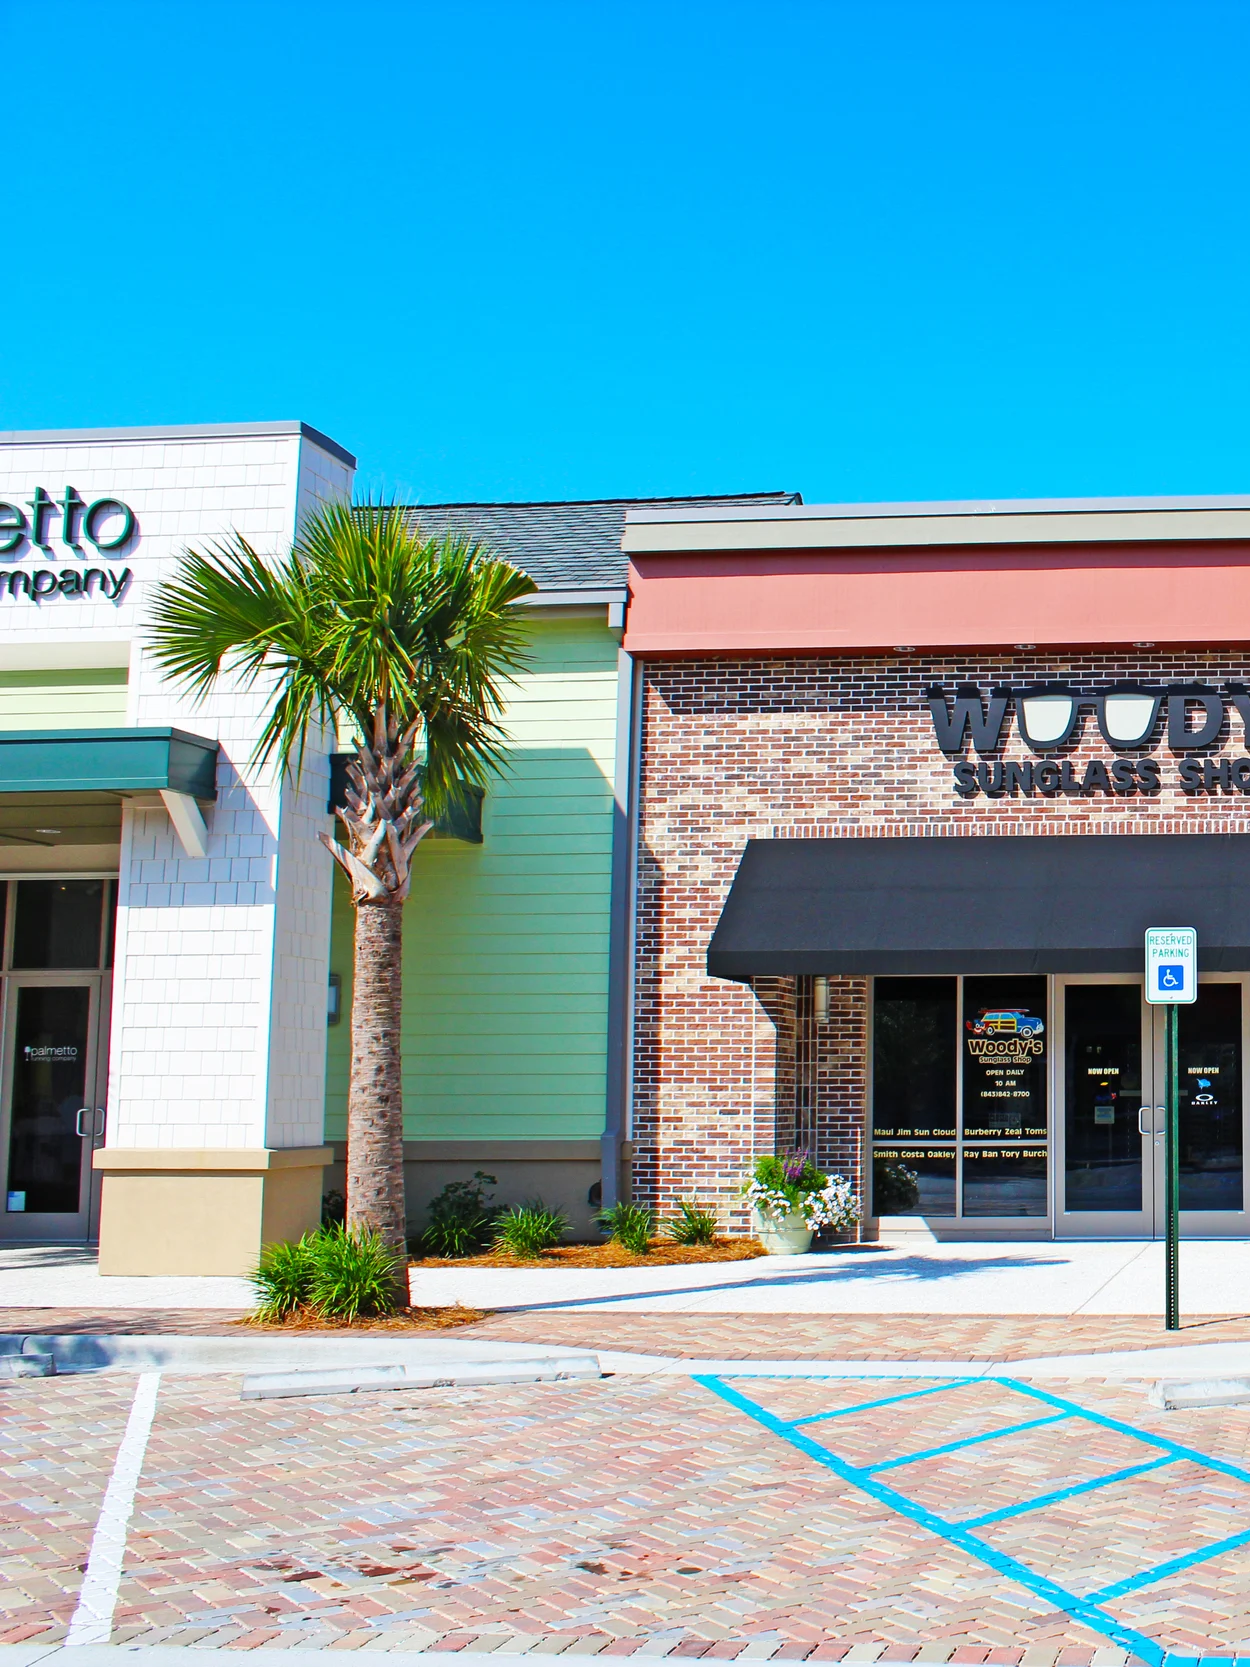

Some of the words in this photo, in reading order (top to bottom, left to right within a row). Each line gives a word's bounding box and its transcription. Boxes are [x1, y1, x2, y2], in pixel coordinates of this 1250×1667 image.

[953, 758, 1161, 794] SUNGLASS
[1150, 935, 1192, 945] RESERVED
[1152, 948, 1189, 957] PARKING
[31, 1046, 78, 1058] palmetto
[968, 1038, 1043, 1056] Woody's
[979, 1056, 1011, 1064] Sunglass
[1012, 1055, 1032, 1064] Shop
[874, 1128, 894, 1136] Maui
[896, 1128, 912, 1136] Jim
[914, 1128, 930, 1136] Sun
[932, 1128, 956, 1136] Cloud
[964, 1128, 1002, 1137] Burberry
[1025, 1127, 1047, 1135] Toms
[873, 1150, 899, 1158] Smith
[901, 1150, 925, 1158] Costa
[927, 1150, 956, 1160] Oakley
[963, 1150, 980, 1160] Ray
[982, 1150, 999, 1158] Ban
[1000, 1150, 1020, 1159] Tory
[1022, 1149, 1048, 1158] Burch
